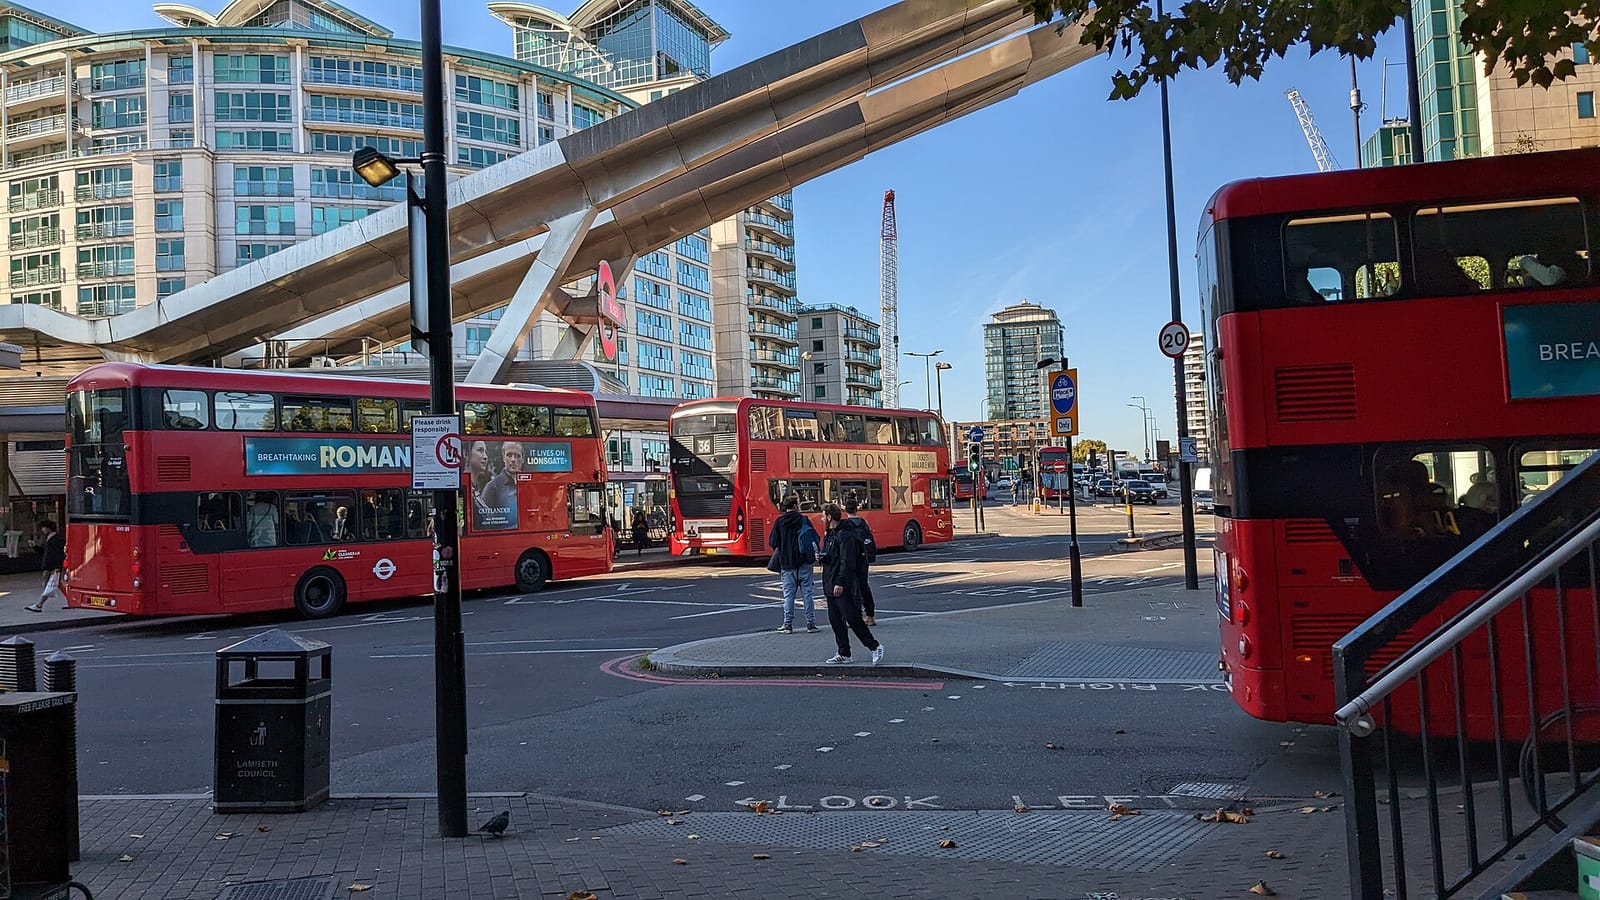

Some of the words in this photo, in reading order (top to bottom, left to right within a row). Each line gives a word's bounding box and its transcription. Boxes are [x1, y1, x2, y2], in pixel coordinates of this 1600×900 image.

[1163, 331, 1185, 349] 20
[1539, 341, 1600, 361] BREA
[1058, 420, 1070, 430] Only
[697, 439, 711, 453] 36
[257, 453, 317, 462] BREATHTAKING
[319, 445, 411, 468] ROMAN
[793, 452, 887, 469] HAMILTON
[236, 760, 278, 768] LAMBETH
[237, 770, 277, 778] COUNCIL
[776, 795, 944, 809] LOOK
[1012, 795, 1180, 808] LEFT
